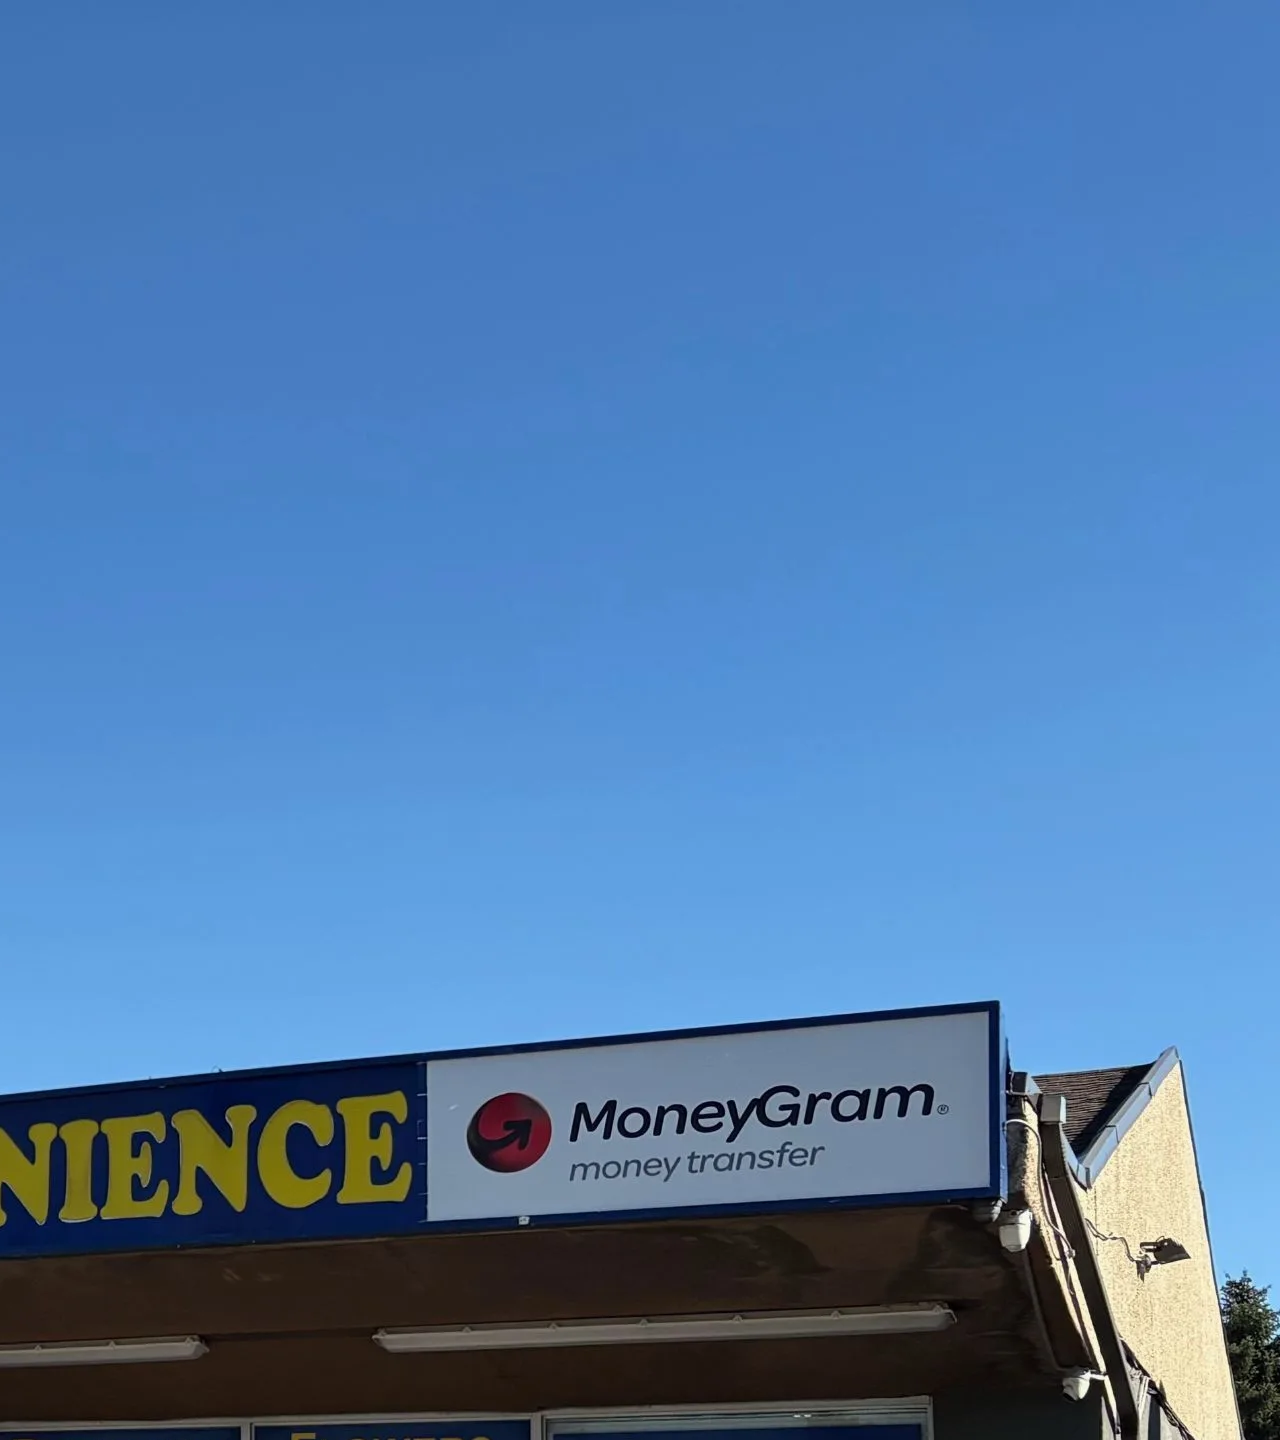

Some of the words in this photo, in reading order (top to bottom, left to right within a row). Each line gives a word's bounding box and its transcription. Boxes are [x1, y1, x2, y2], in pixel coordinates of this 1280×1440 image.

[569, 1082, 935, 1143] MoneyGram
[569, 1154, 681, 1182] money
[688, 1141, 826, 1174] transfer
